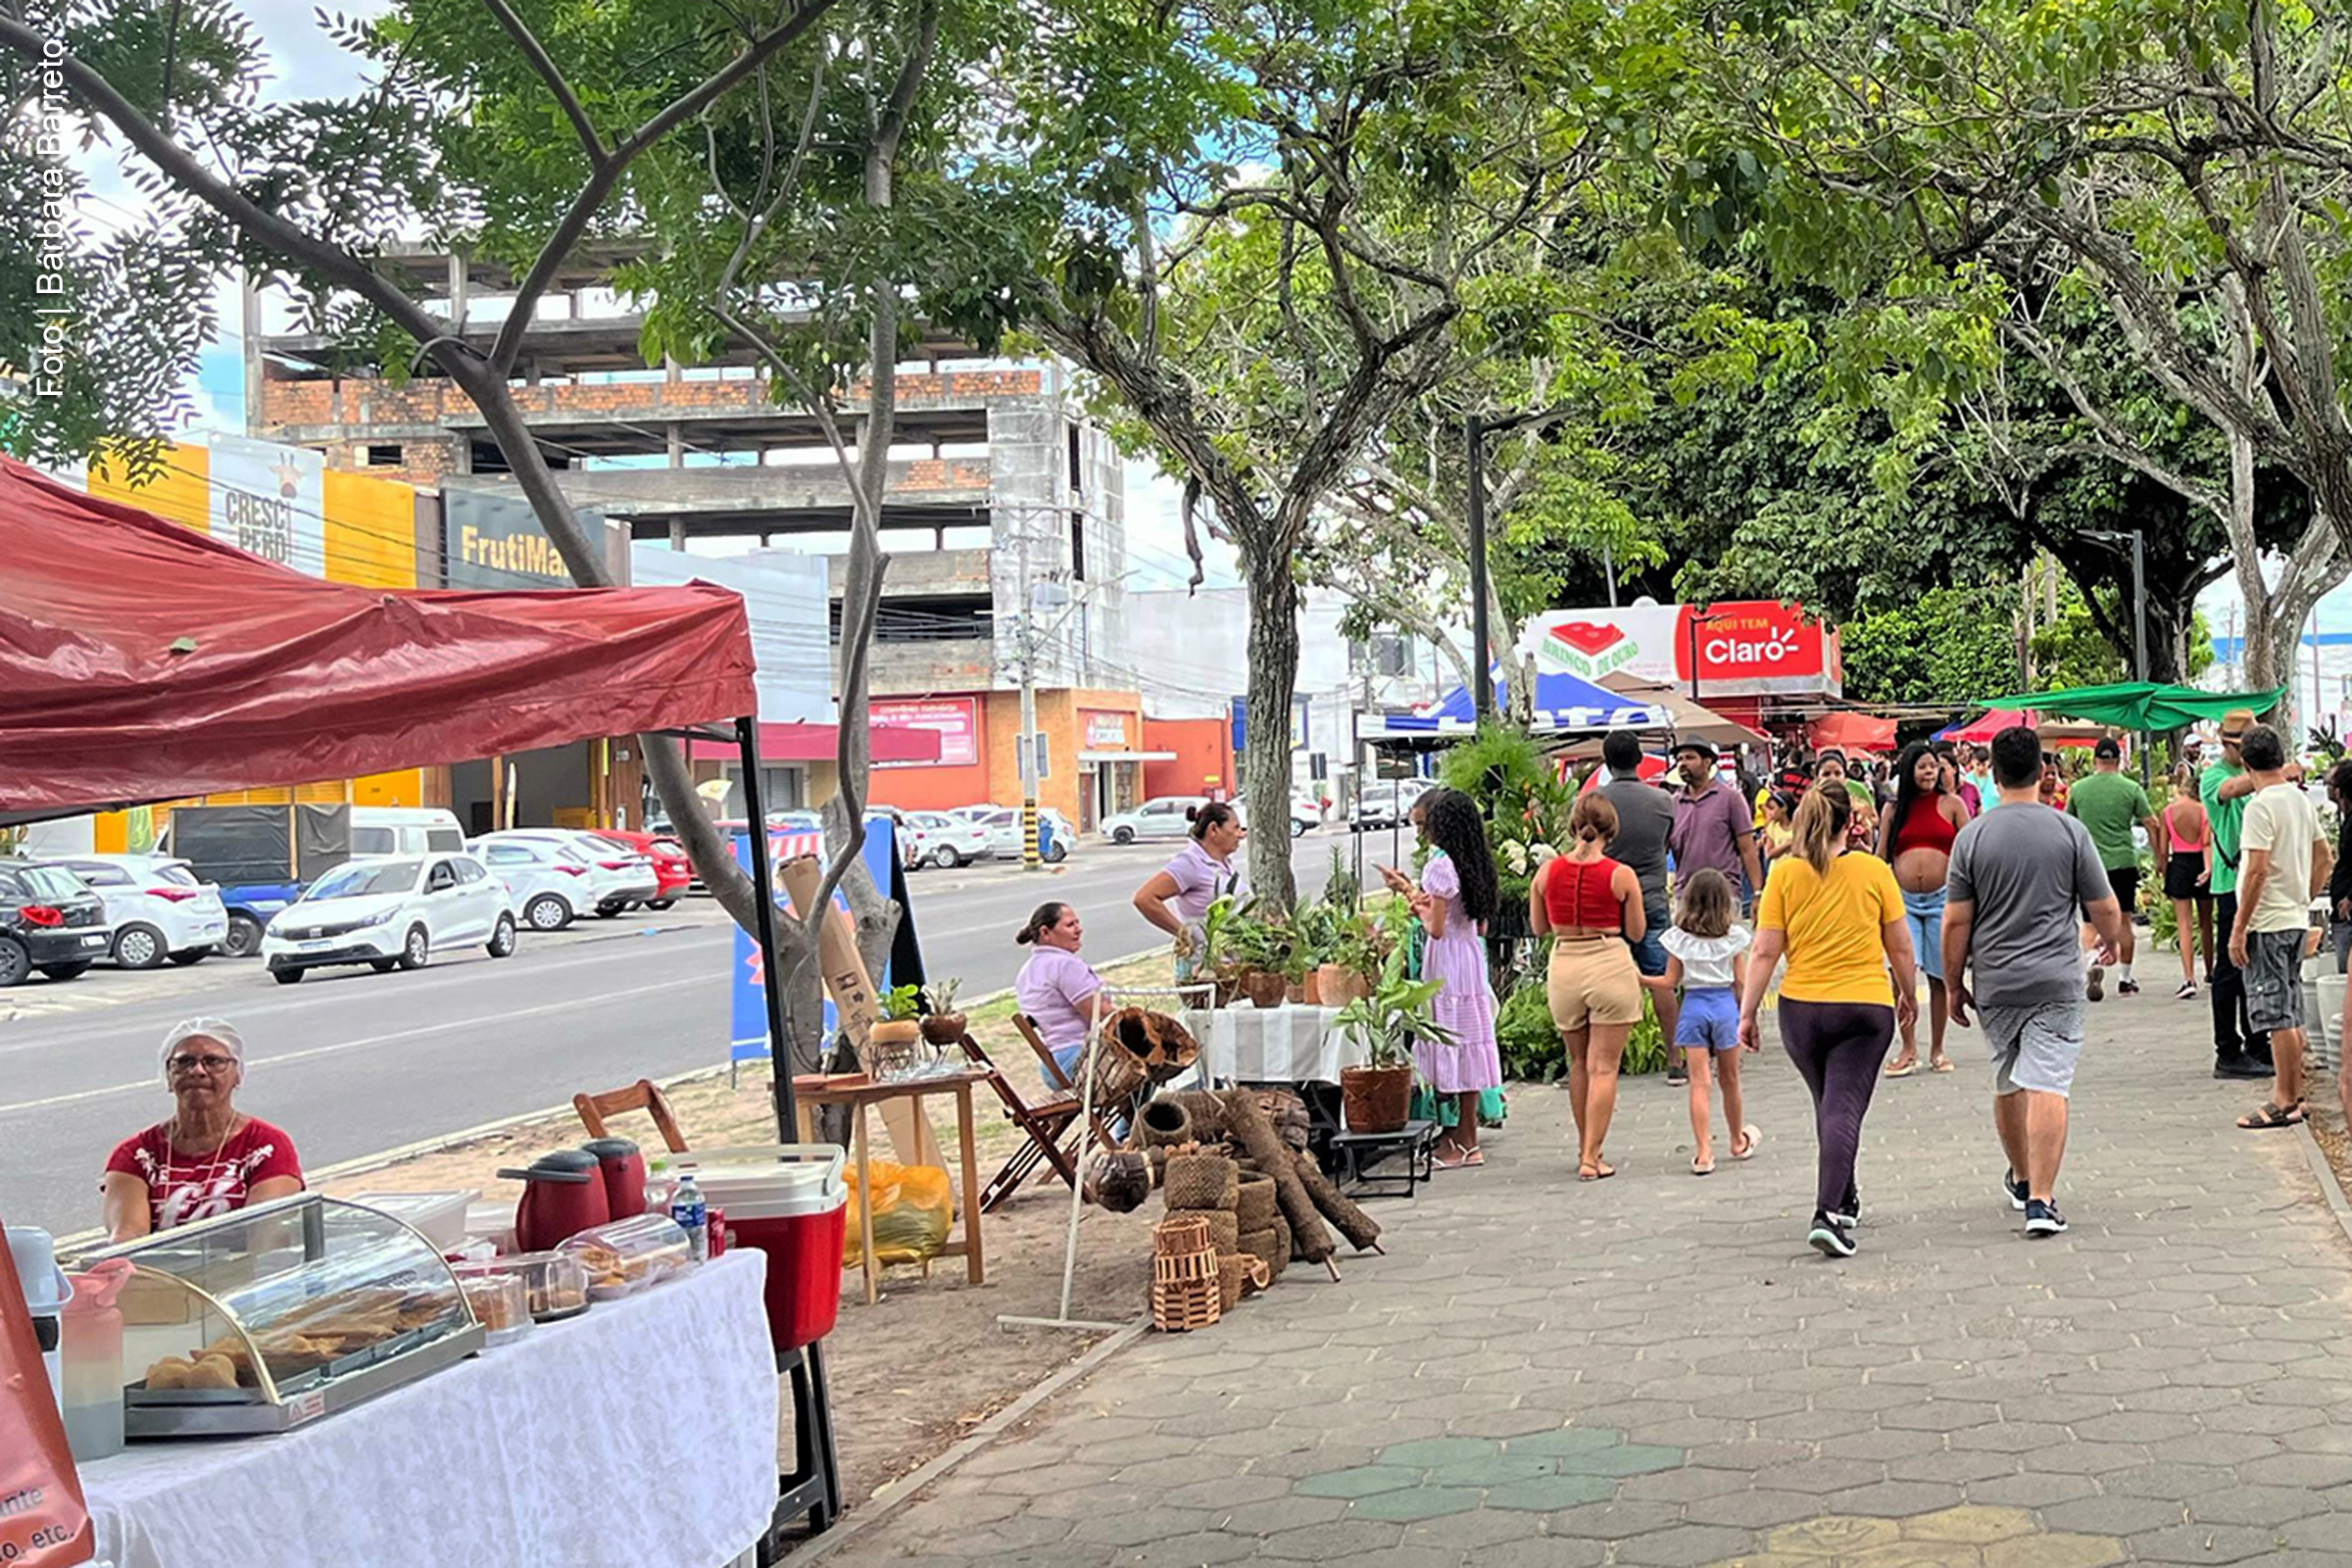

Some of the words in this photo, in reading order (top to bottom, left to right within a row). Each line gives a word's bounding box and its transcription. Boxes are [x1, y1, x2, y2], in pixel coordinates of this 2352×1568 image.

[1705, 618, 1738, 633] AQUI
[1740, 618, 1768, 630] TEM
[1542, 638, 1592, 677] BRINCO
[1704, 635, 1786, 664] Claro
